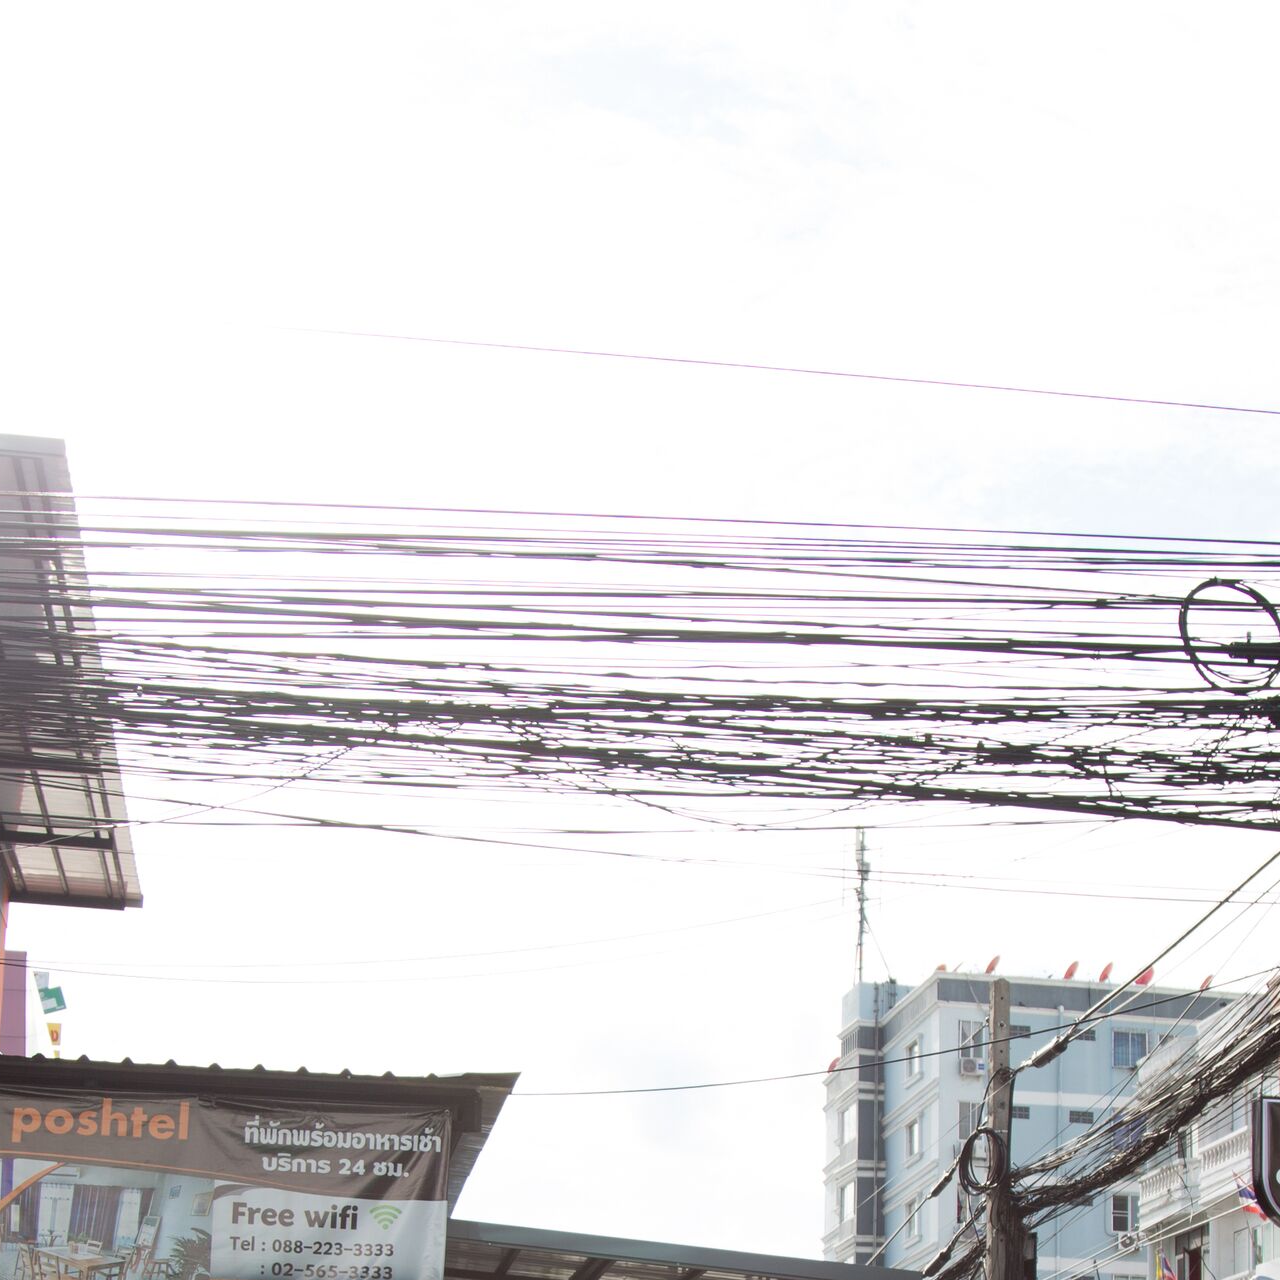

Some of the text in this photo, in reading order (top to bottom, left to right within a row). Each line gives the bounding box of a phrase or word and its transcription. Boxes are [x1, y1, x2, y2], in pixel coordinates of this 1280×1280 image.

[11, 1097, 191, 1143] poshtel
[244, 1115, 442, 1153] ที่พักพร้อมอาหารเช้า
[262, 1152, 410, 1178] บริการ 24 ชม.
[232, 1202, 358, 1230] Free wifi
[230, 1236, 256, 1252] Tel
[272, 1239, 394, 1257] 088-223-3333
[271, 1262, 393, 1280] 02-565-3333
